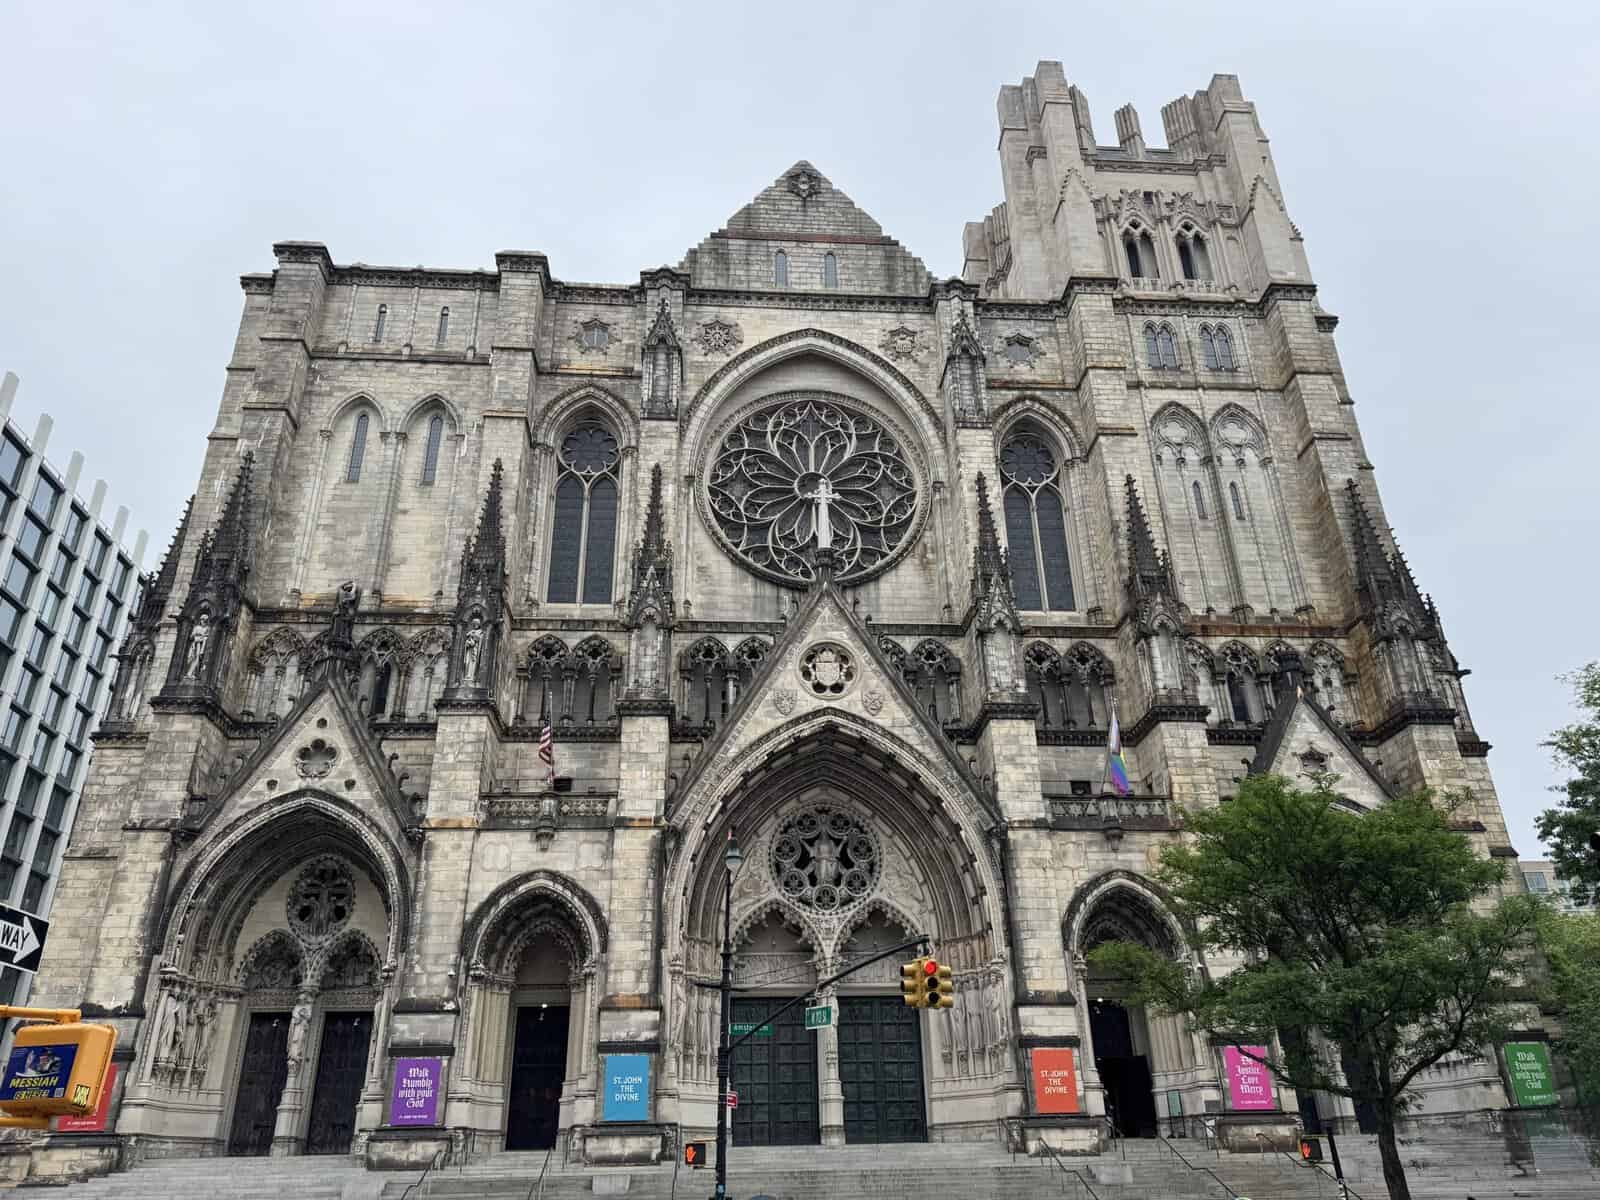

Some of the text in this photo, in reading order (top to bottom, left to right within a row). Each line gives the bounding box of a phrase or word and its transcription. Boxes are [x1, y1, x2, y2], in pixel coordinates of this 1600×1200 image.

[1, 923, 30, 951] WAY
[408, 1067, 429, 1078] Walk
[1051, 1070, 1069, 1078] JOHN
[9, 1076, 59, 1089] MESSIAH
[623, 1076, 642, 1084] JOHN
[1048, 1078, 1063, 1086] THE
[398, 1088, 416, 1098] with
[620, 1085, 635, 1093] THE
[1044, 1086, 1068, 1094] DIVINE
[1240, 1084, 1264, 1096] Mercy
[615, 1093, 640, 1101] DIVINE
[406, 1098, 425, 1109] God
